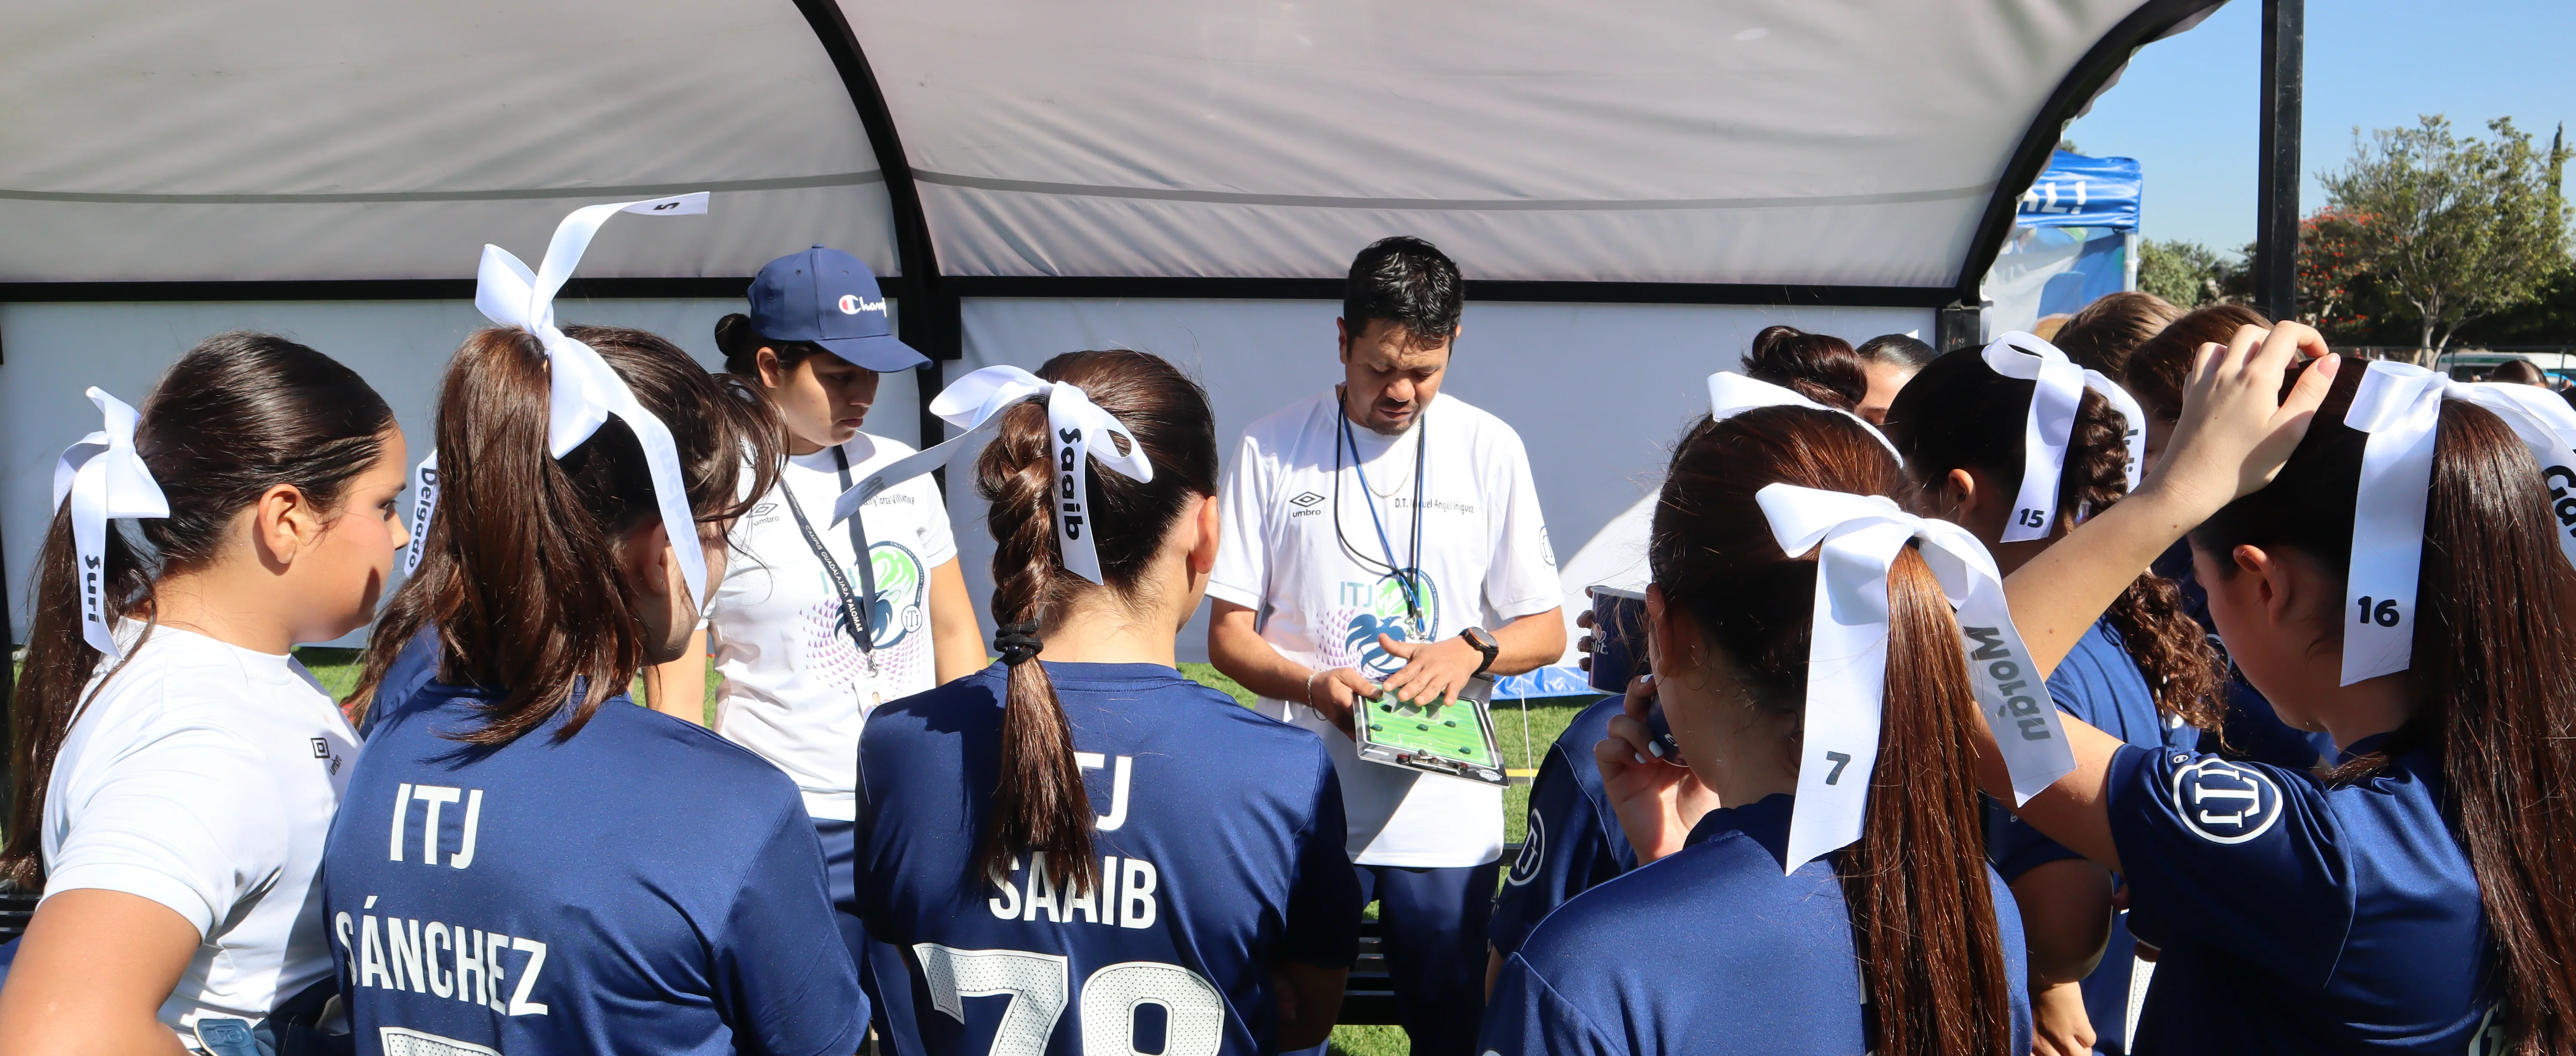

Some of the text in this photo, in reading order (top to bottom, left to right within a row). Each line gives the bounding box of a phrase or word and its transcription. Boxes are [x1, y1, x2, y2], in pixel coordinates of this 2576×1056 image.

[653, 202, 680, 210] 5
[1059, 427, 1084, 541] Saaib
[409, 467, 438, 568] Delgado
[1292, 508, 1321, 517] umbro
[1395, 498, 1408, 508] D.T.
[2019, 508, 2044, 528] 15
[753, 514, 780, 526] umbro
[84, 554, 101, 624] Suri
[805, 525, 863, 633] CAMPUS GUADALAJARA PALOMAR
[1340, 581, 1373, 608] ITJ
[905, 610, 920, 627] ITJ
[2357, 596, 2400, 627] 16
[329, 755, 342, 776] umbro
[1825, 750, 1851, 785] 7
[2195, 768, 2260, 828] ITJ
[390, 783, 483, 870] ITJ
[1516, 822, 1537, 874] TJ
[335, 895, 548, 1016] SÁNCHEZ
